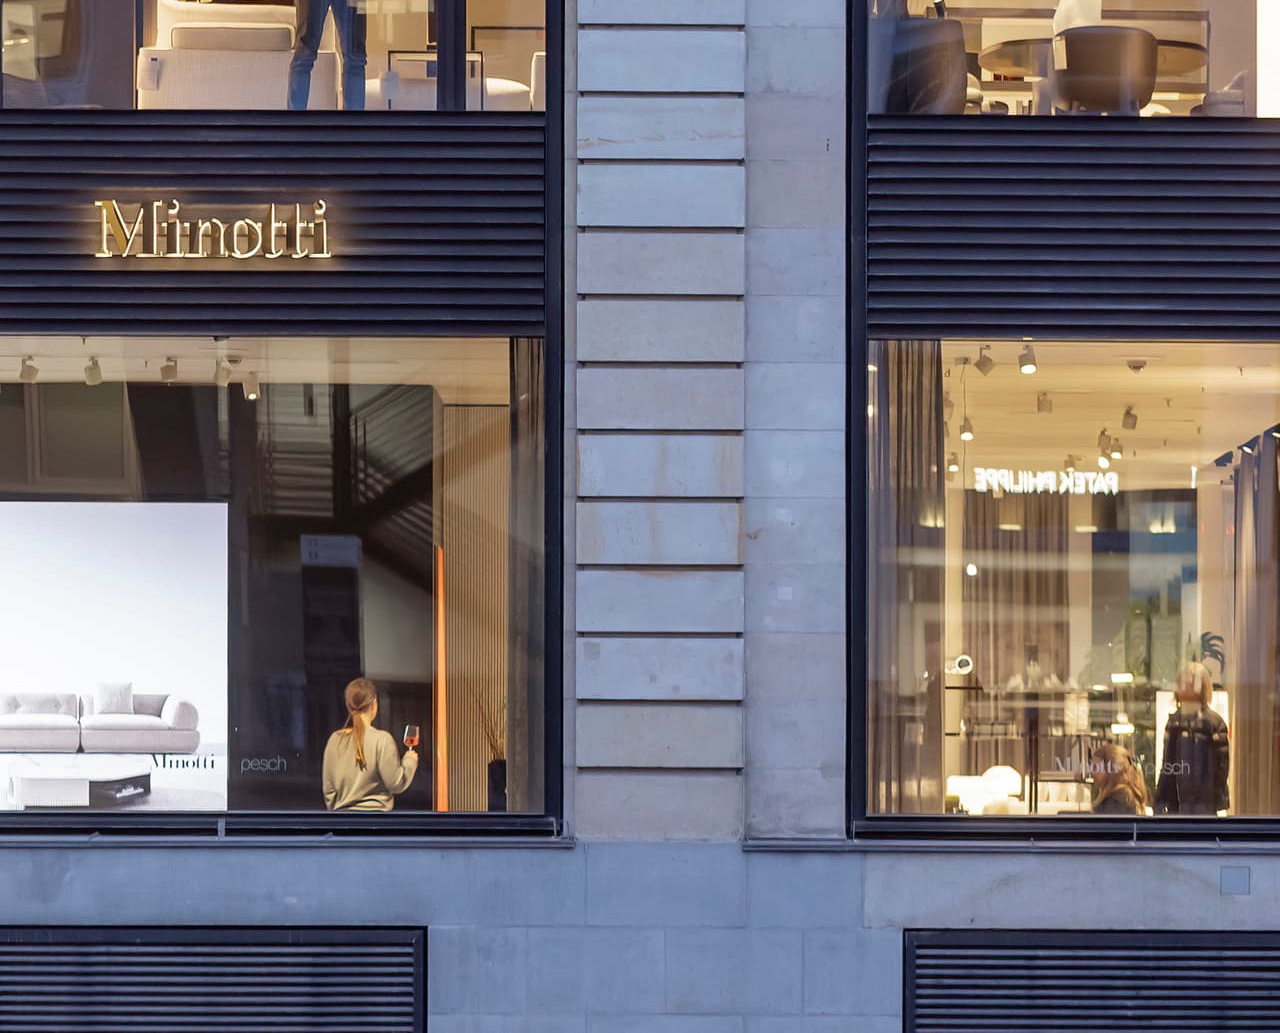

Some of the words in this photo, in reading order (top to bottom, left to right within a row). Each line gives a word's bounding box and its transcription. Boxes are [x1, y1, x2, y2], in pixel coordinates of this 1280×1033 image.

[94, 199, 332, 258] Minotti
[151, 753, 215, 769] Minotti
[240, 754, 287, 774] pesch
[1145, 759, 1191, 777] psch
